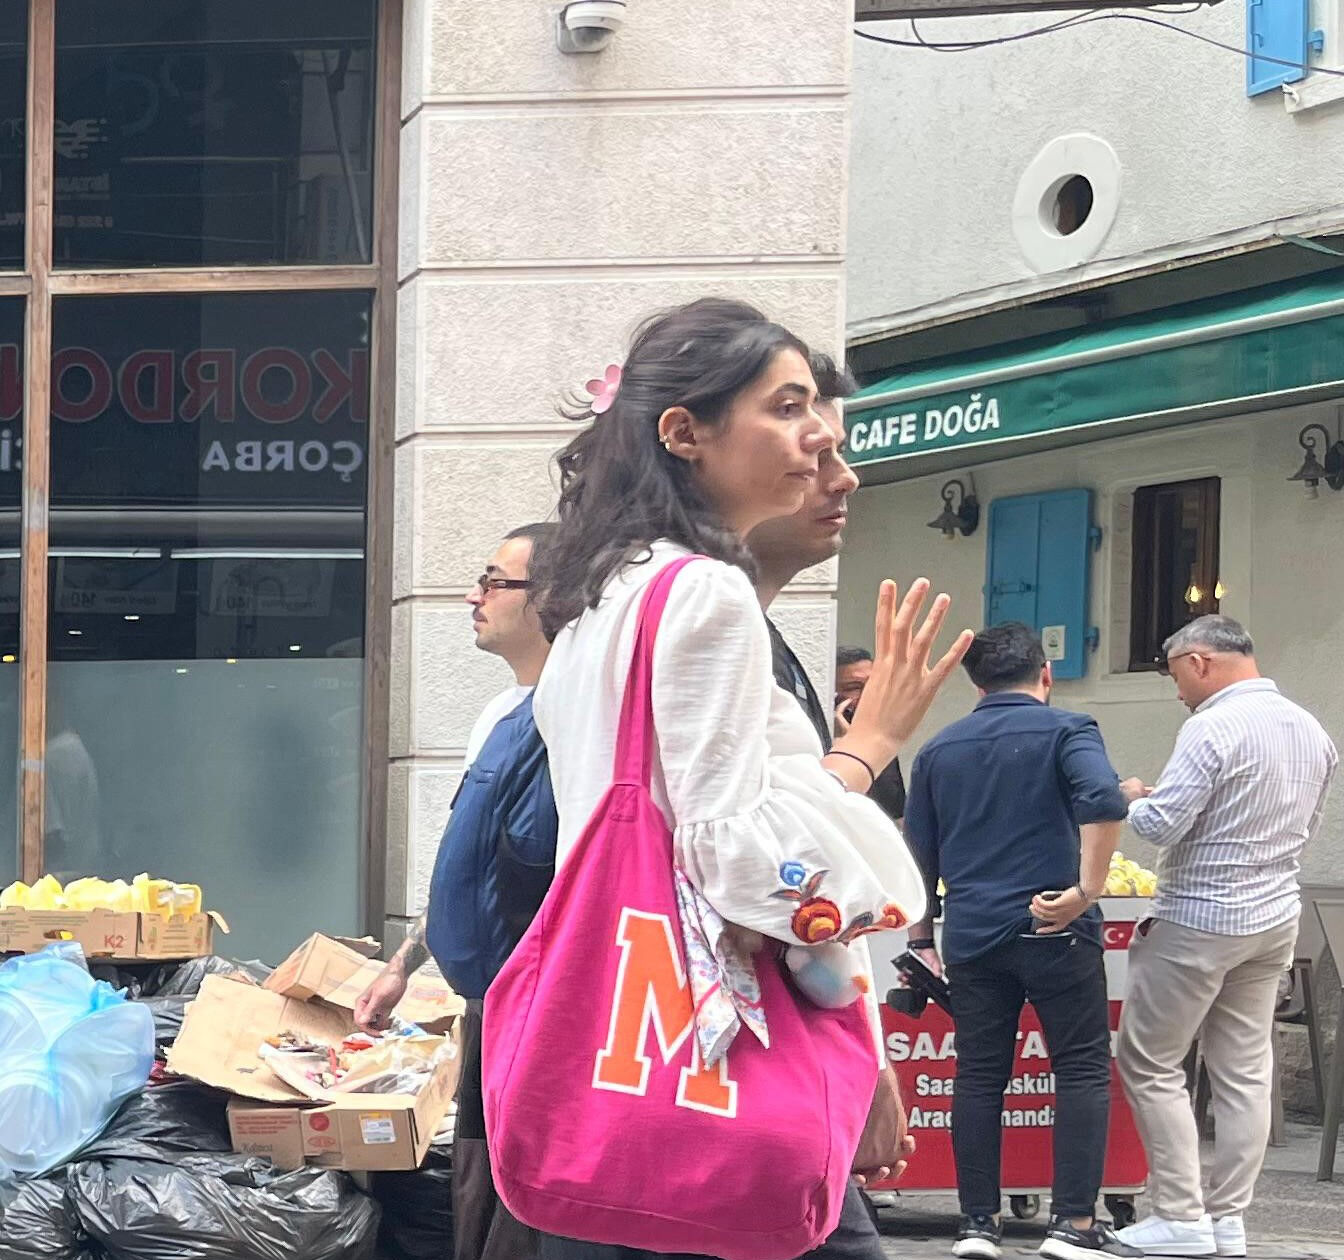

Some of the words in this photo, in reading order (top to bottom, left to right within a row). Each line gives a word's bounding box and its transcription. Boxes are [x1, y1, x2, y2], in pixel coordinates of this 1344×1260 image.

[850, 413, 917, 453] CAFE
[924, 393, 1000, 441] DOĞA
[103, 933, 126, 949] K2
[592, 907, 738, 1118] M
[886, 1031, 956, 1061] SAA
[916, 1073, 955, 1096] Saa
